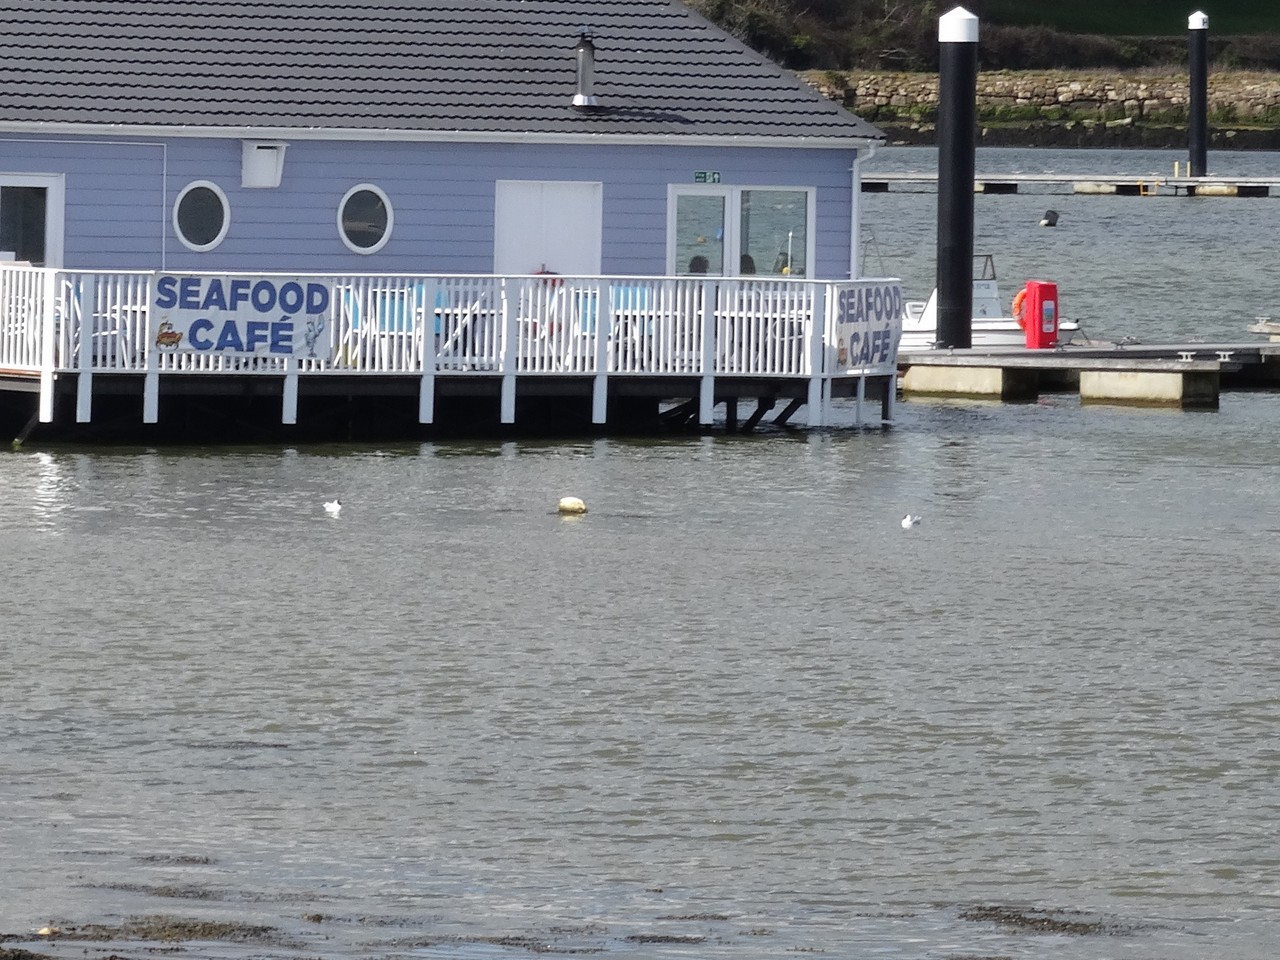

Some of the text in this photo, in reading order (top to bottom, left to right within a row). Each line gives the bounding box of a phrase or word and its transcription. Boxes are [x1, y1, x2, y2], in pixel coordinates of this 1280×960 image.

[155, 276, 329, 314] SEAFOOD
[838, 286, 901, 324] SEAFOOD
[188, 315, 294, 354] CAFÉ
[849, 323, 891, 366] CAFÉ
